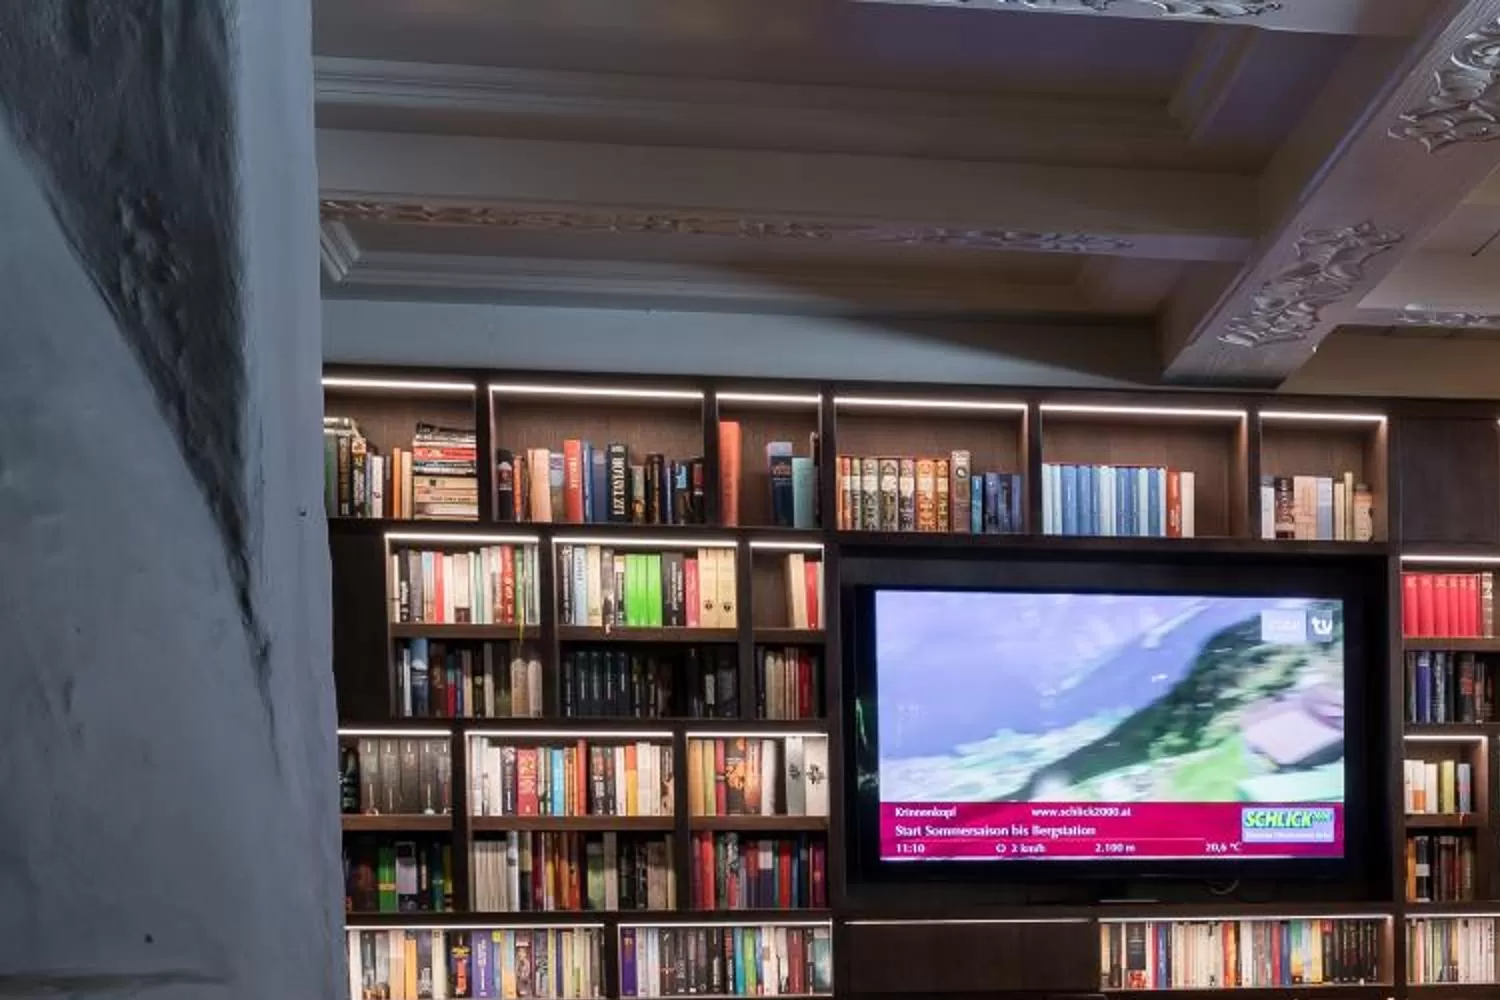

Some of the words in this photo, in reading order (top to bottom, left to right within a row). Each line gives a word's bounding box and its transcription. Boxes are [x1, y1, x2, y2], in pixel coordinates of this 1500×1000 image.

[611, 457, 625, 497] TAYLOR
[1245, 811, 1313, 828] SCHLICK
[895, 824, 922, 837] Start
[925, 825, 1009, 837] Sommersaison
[1011, 824, 1029, 836] bis
[1031, 824, 1097, 839] Bergstation
[896, 843, 925, 853] 11:10
